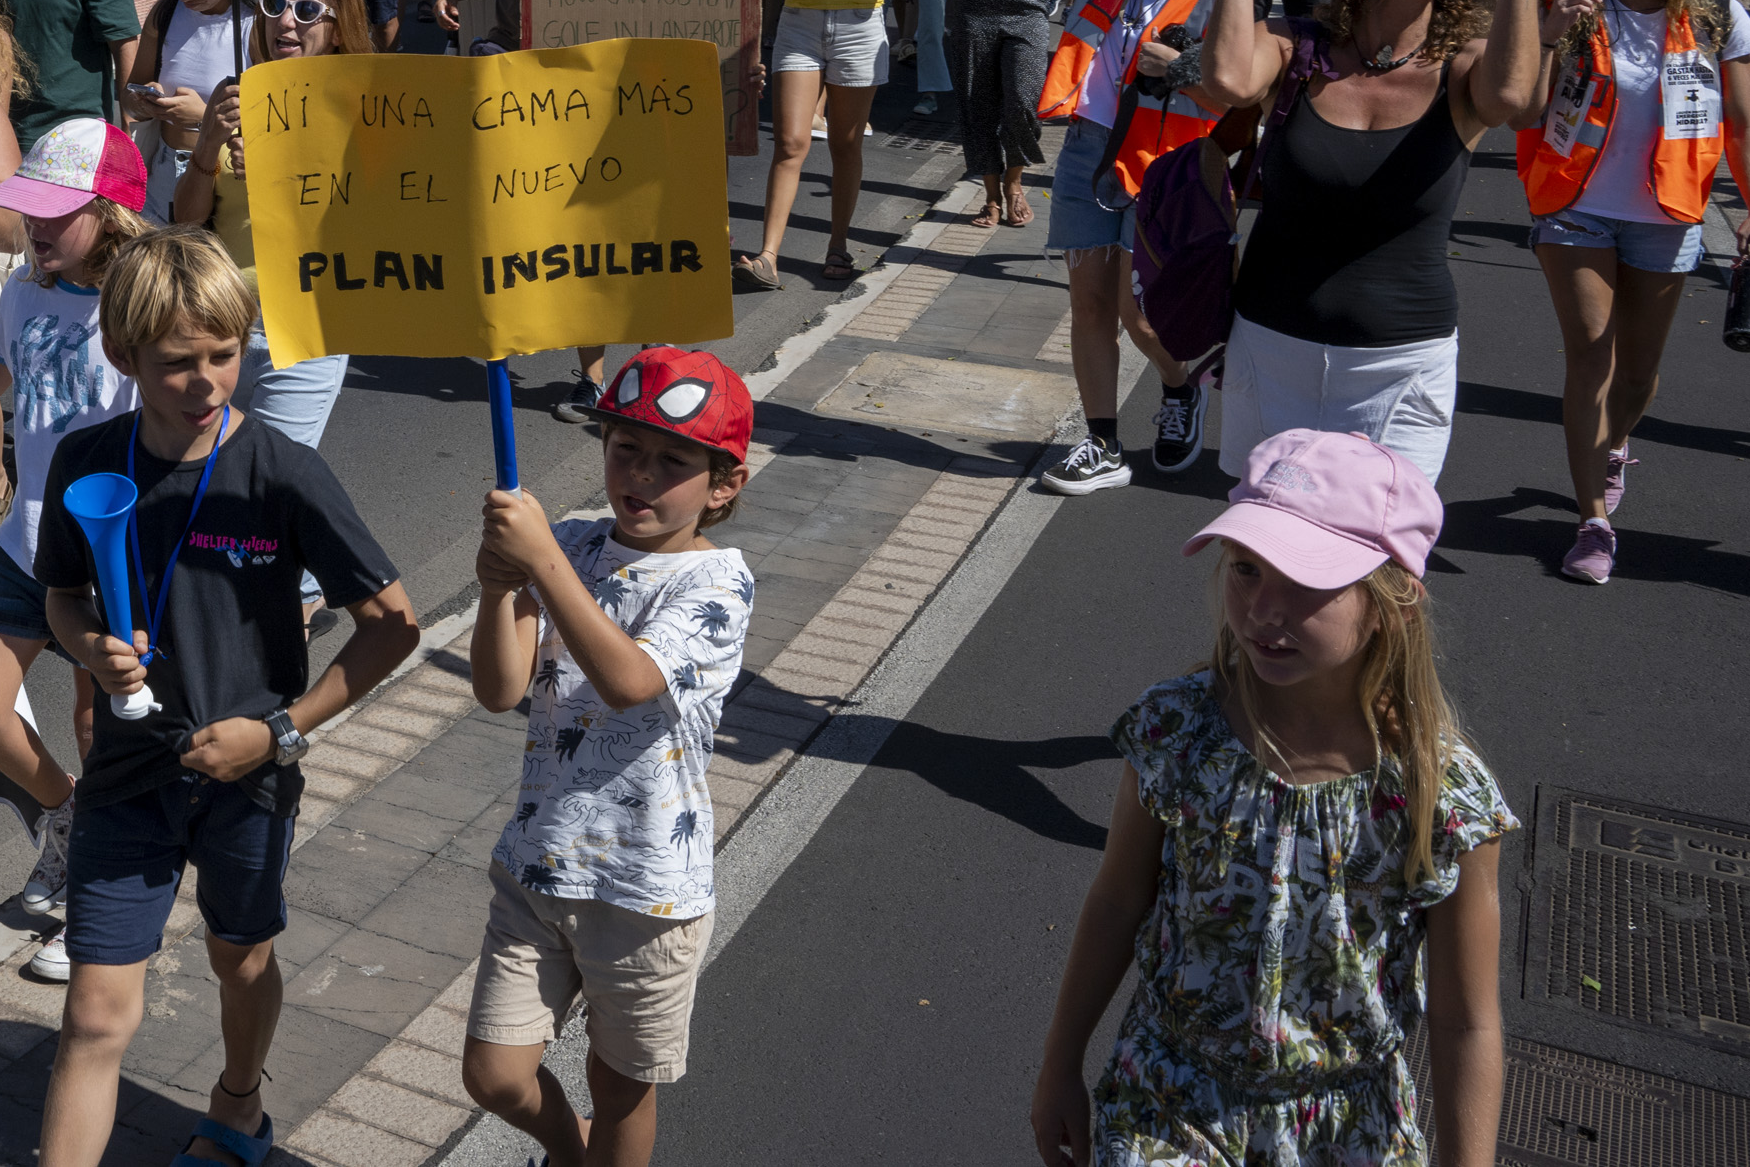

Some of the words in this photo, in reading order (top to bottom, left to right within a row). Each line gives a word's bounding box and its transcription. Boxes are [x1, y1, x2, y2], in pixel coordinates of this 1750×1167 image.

[615, 21, 637, 38] IN
[362, 92, 435, 128] UNA
[472, 87, 590, 132] CAMA
[618, 78, 694, 118] MÁS
[300, 172, 350, 206] EN
[400, 171, 448, 203] EL
[493, 156, 623, 204] NUEVO
[299, 250, 445, 293] PLAN
[482, 239, 704, 295] INSULAR
[189, 531, 236, 550] SHELTER
